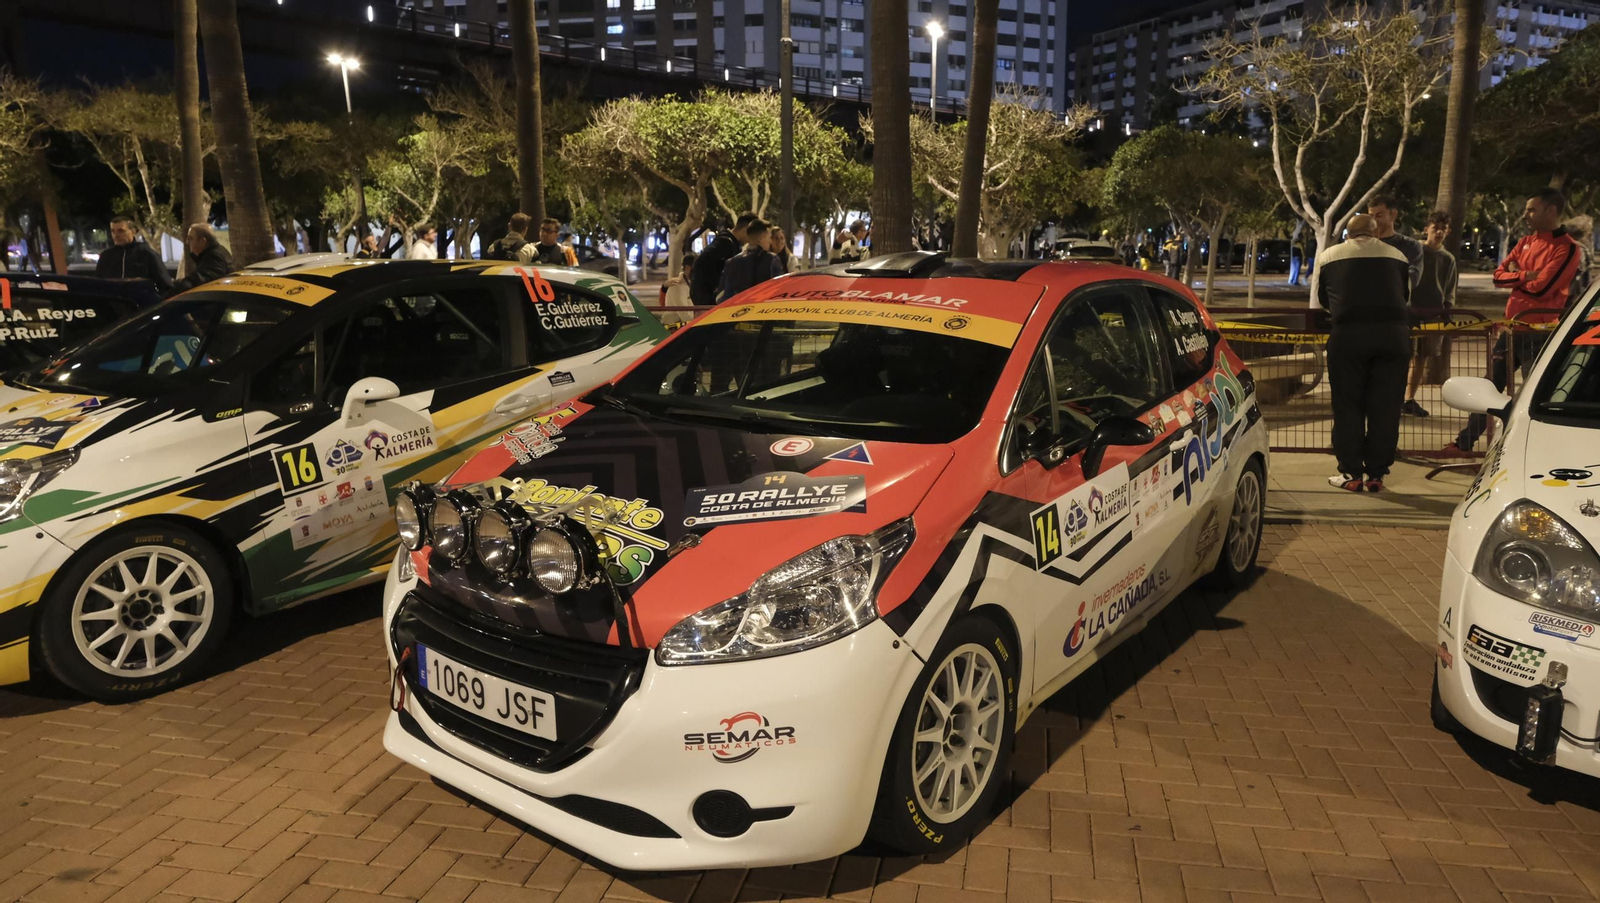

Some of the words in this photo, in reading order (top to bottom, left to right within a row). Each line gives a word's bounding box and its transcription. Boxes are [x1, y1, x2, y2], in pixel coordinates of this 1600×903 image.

[513, 266, 555, 303] 16
[37, 308, 97, 322] Reyes
[534, 302, 603, 317] E.Gutiérrez
[757, 306, 821, 315] AUTOMÓVIL
[824, 307, 857, 315] CLUB
[857, 309, 876, 317] DE
[876, 311, 933, 324] ALMERÍA
[541, 315, 609, 330] C.Gutiérrez
[0, 326, 59, 341] P.Ruiz
[391, 429, 419, 443] COSTA
[419, 426, 431, 436] DE
[386, 434, 434, 458] ALMERÍA
[781, 440, 803, 452] E
[281, 447, 317, 487] 16
[763, 474, 788, 486] 14
[700, 492, 736, 506] 50
[737, 484, 848, 502] RALLYE
[1104, 487, 1121, 505] COSTA
[1120, 482, 1128, 495] DE
[699, 502, 750, 514] COSTA
[751, 500, 774, 510] DE
[775, 495, 847, 507] ALMERÍA
[1100, 494, 1128, 525] ALMERÍA
[1036, 510, 1060, 563] 14
[1089, 610, 1106, 639] LA
[1107, 573, 1159, 625] CAÑADA,
[420, 670, 427, 681] E
[1469, 652, 1536, 682] automovilismo
[1496, 659, 1537, 675] andaluza
[433, 659, 486, 711] 1069
[496, 687, 547, 730] JSF
[683, 726, 796, 746] SEMAR
[684, 737, 797, 752] NEUMATICOS
